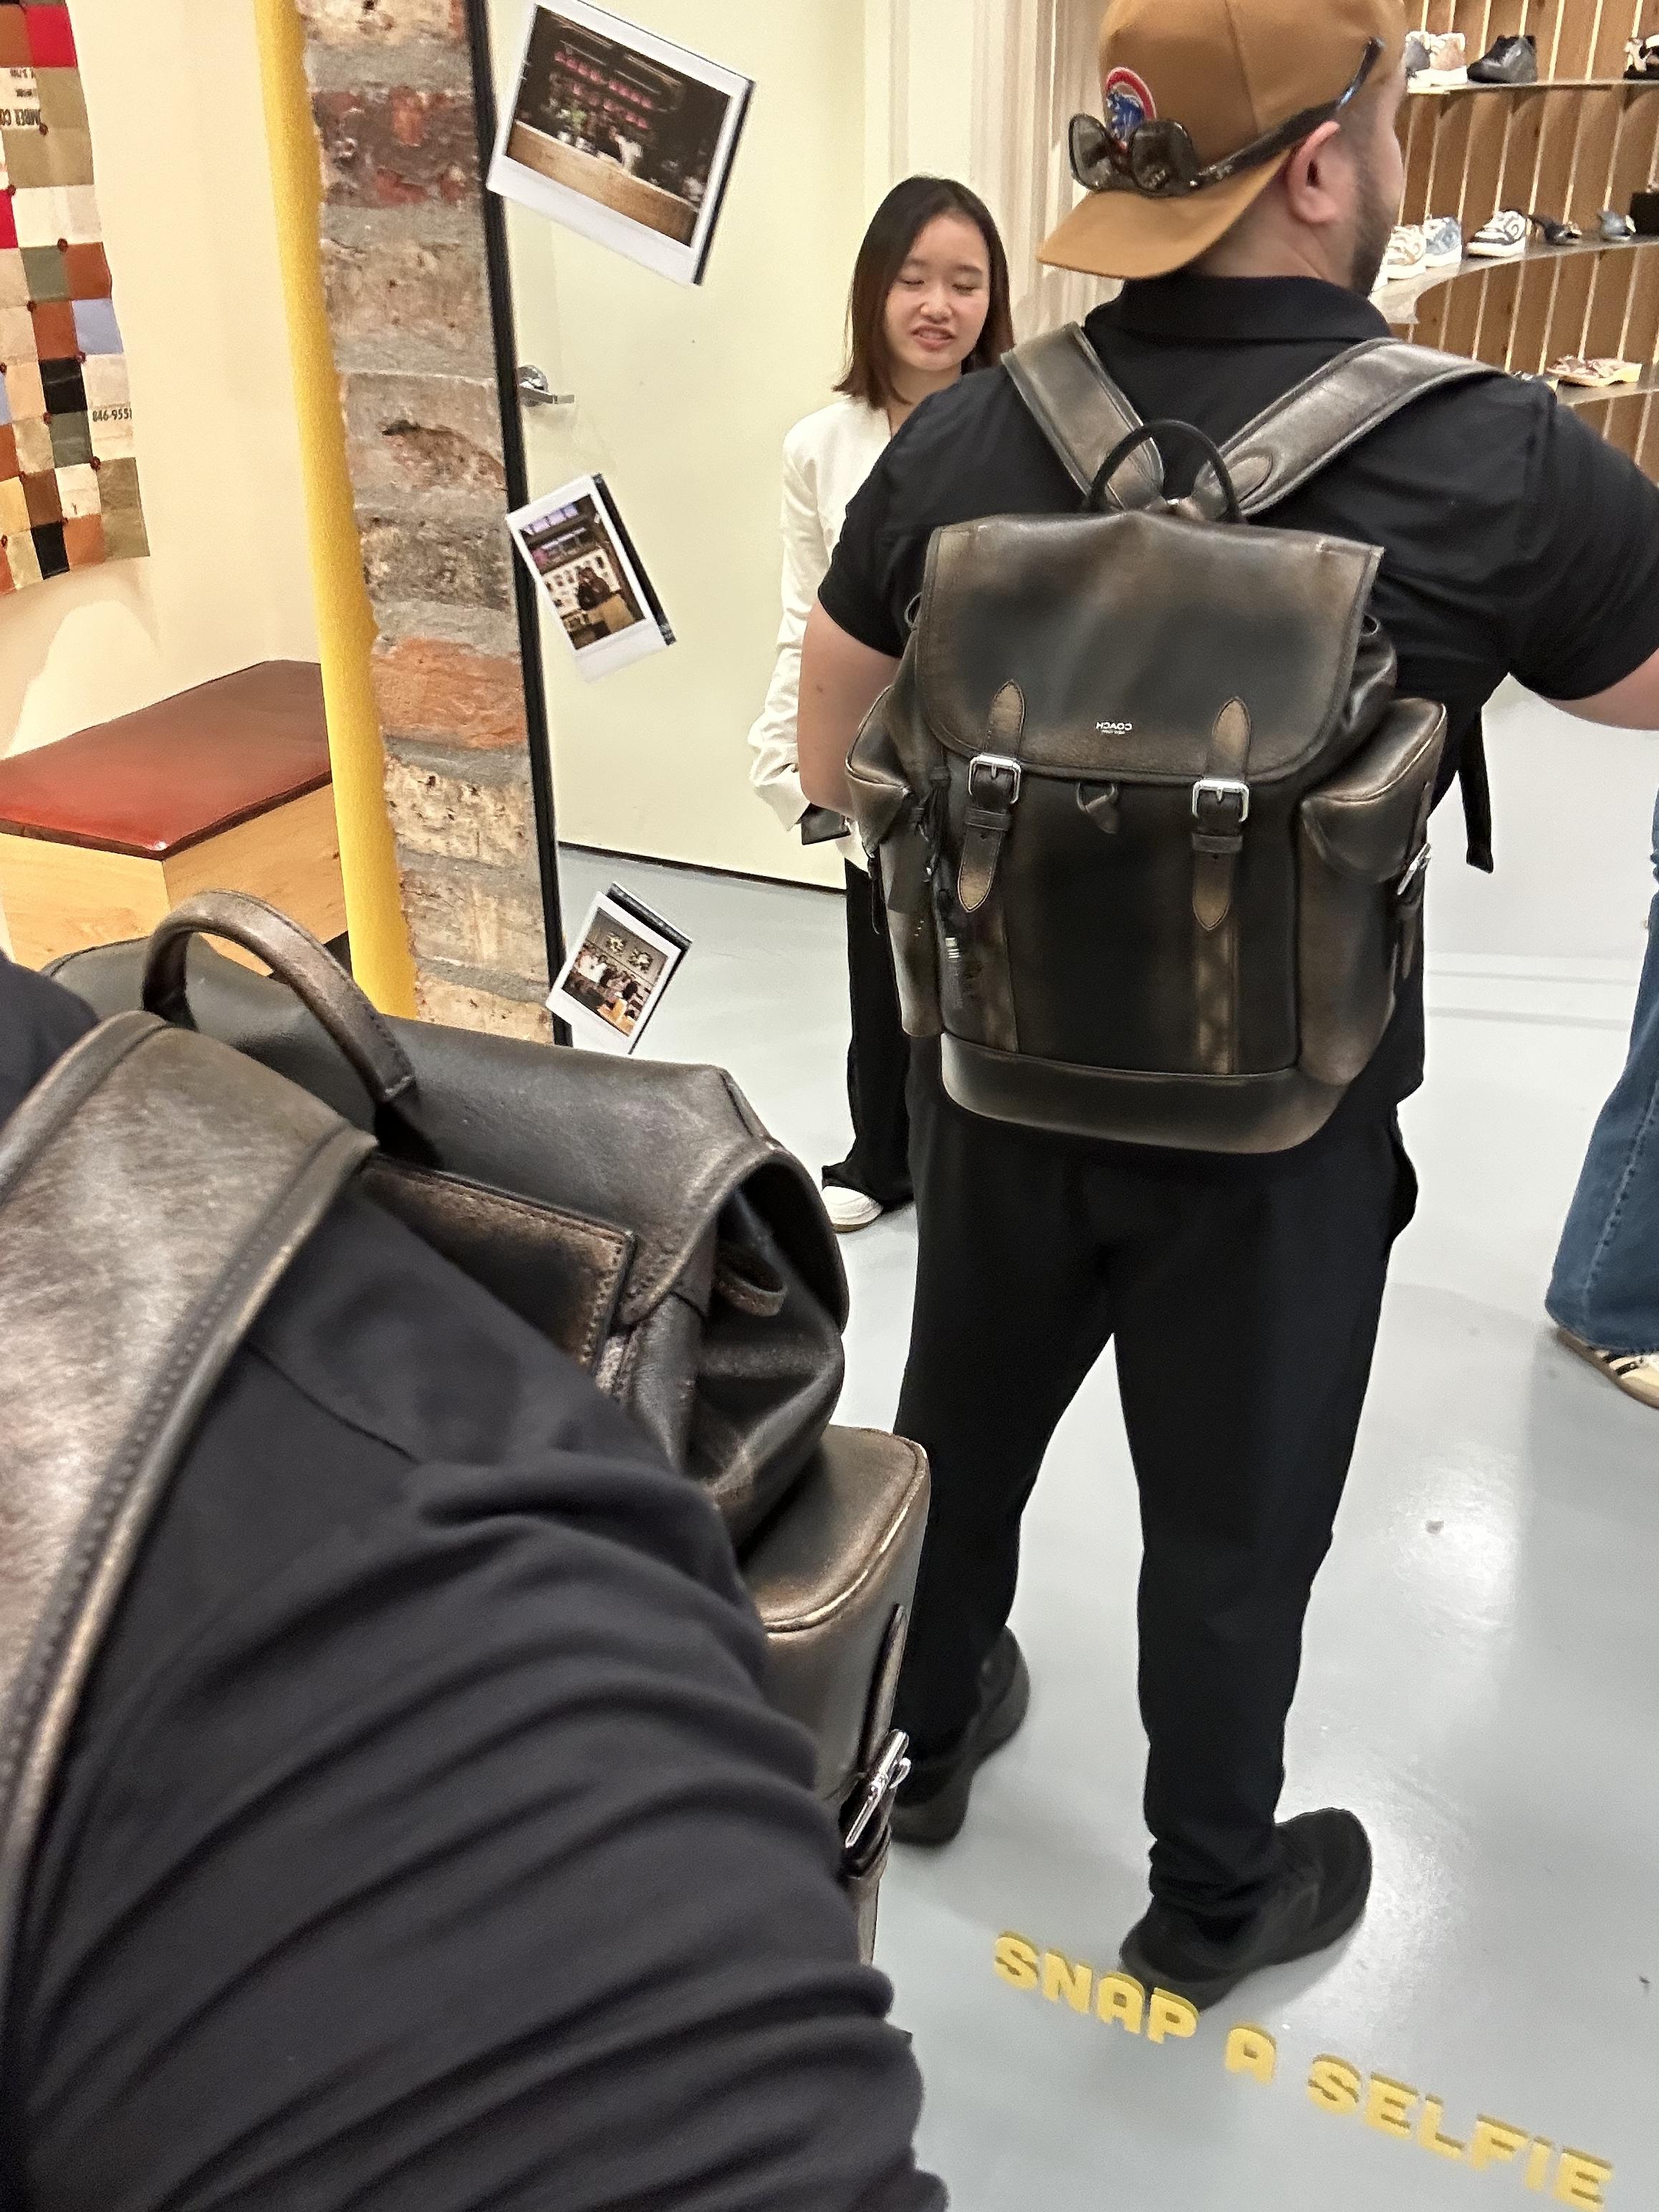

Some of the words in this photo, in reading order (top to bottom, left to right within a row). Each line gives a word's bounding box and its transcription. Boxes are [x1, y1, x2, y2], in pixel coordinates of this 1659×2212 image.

[994, 1930, 1200, 2044] SNAP
[1225, 2021, 1277, 2084] A
[1307, 2053, 1613, 2212] SELFIE
